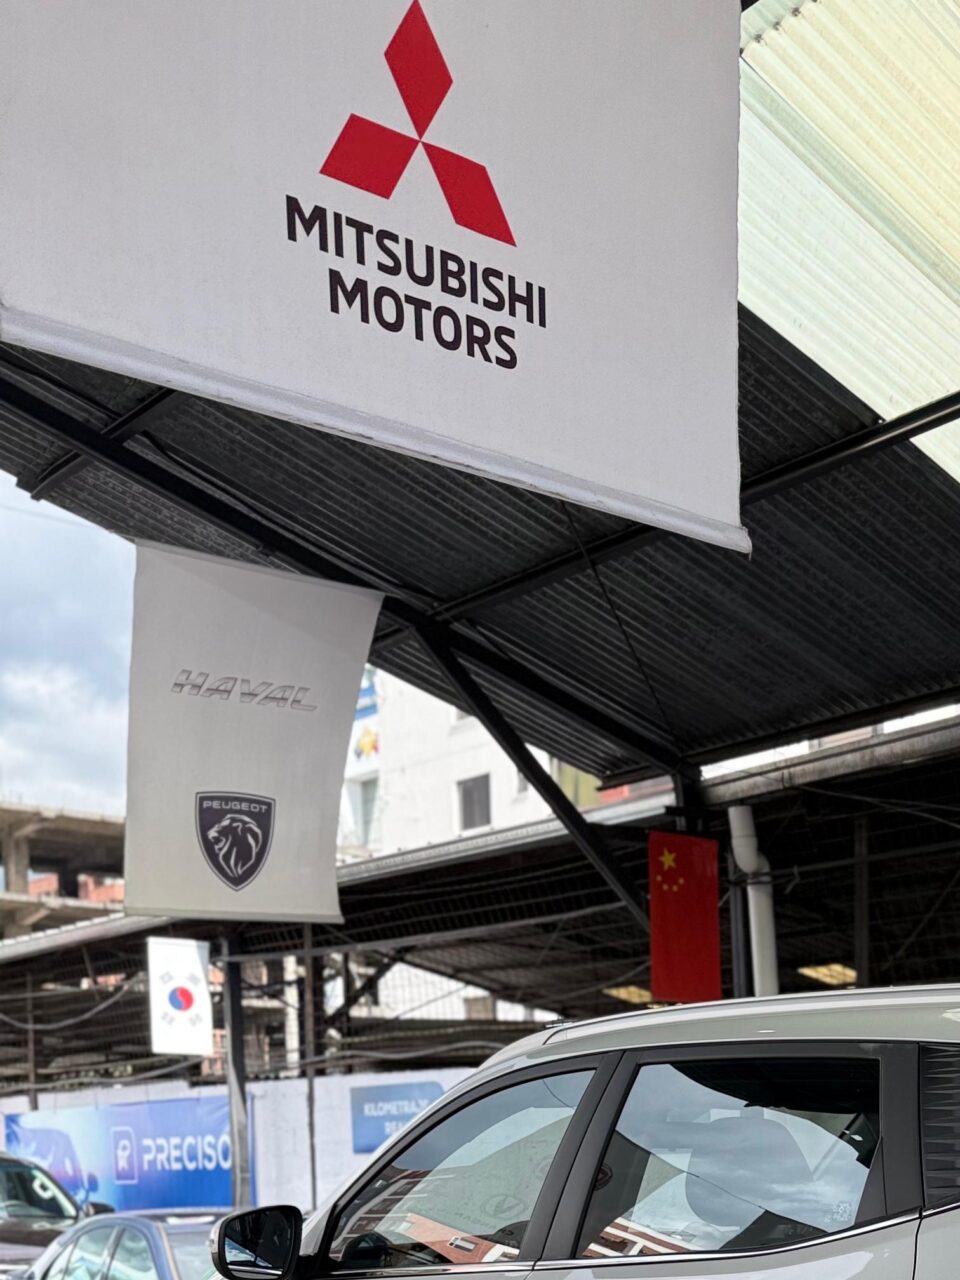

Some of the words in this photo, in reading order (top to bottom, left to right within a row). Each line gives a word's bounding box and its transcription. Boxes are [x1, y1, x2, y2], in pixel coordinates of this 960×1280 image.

[285, 194, 547, 328] MITSUBISHI
[328, 268, 518, 370] MOTORS
[171, 668, 319, 711] HAVAL
[202, 800, 269, 813] PEUGEOT
[142, 1134, 232, 1171] PRECISO
